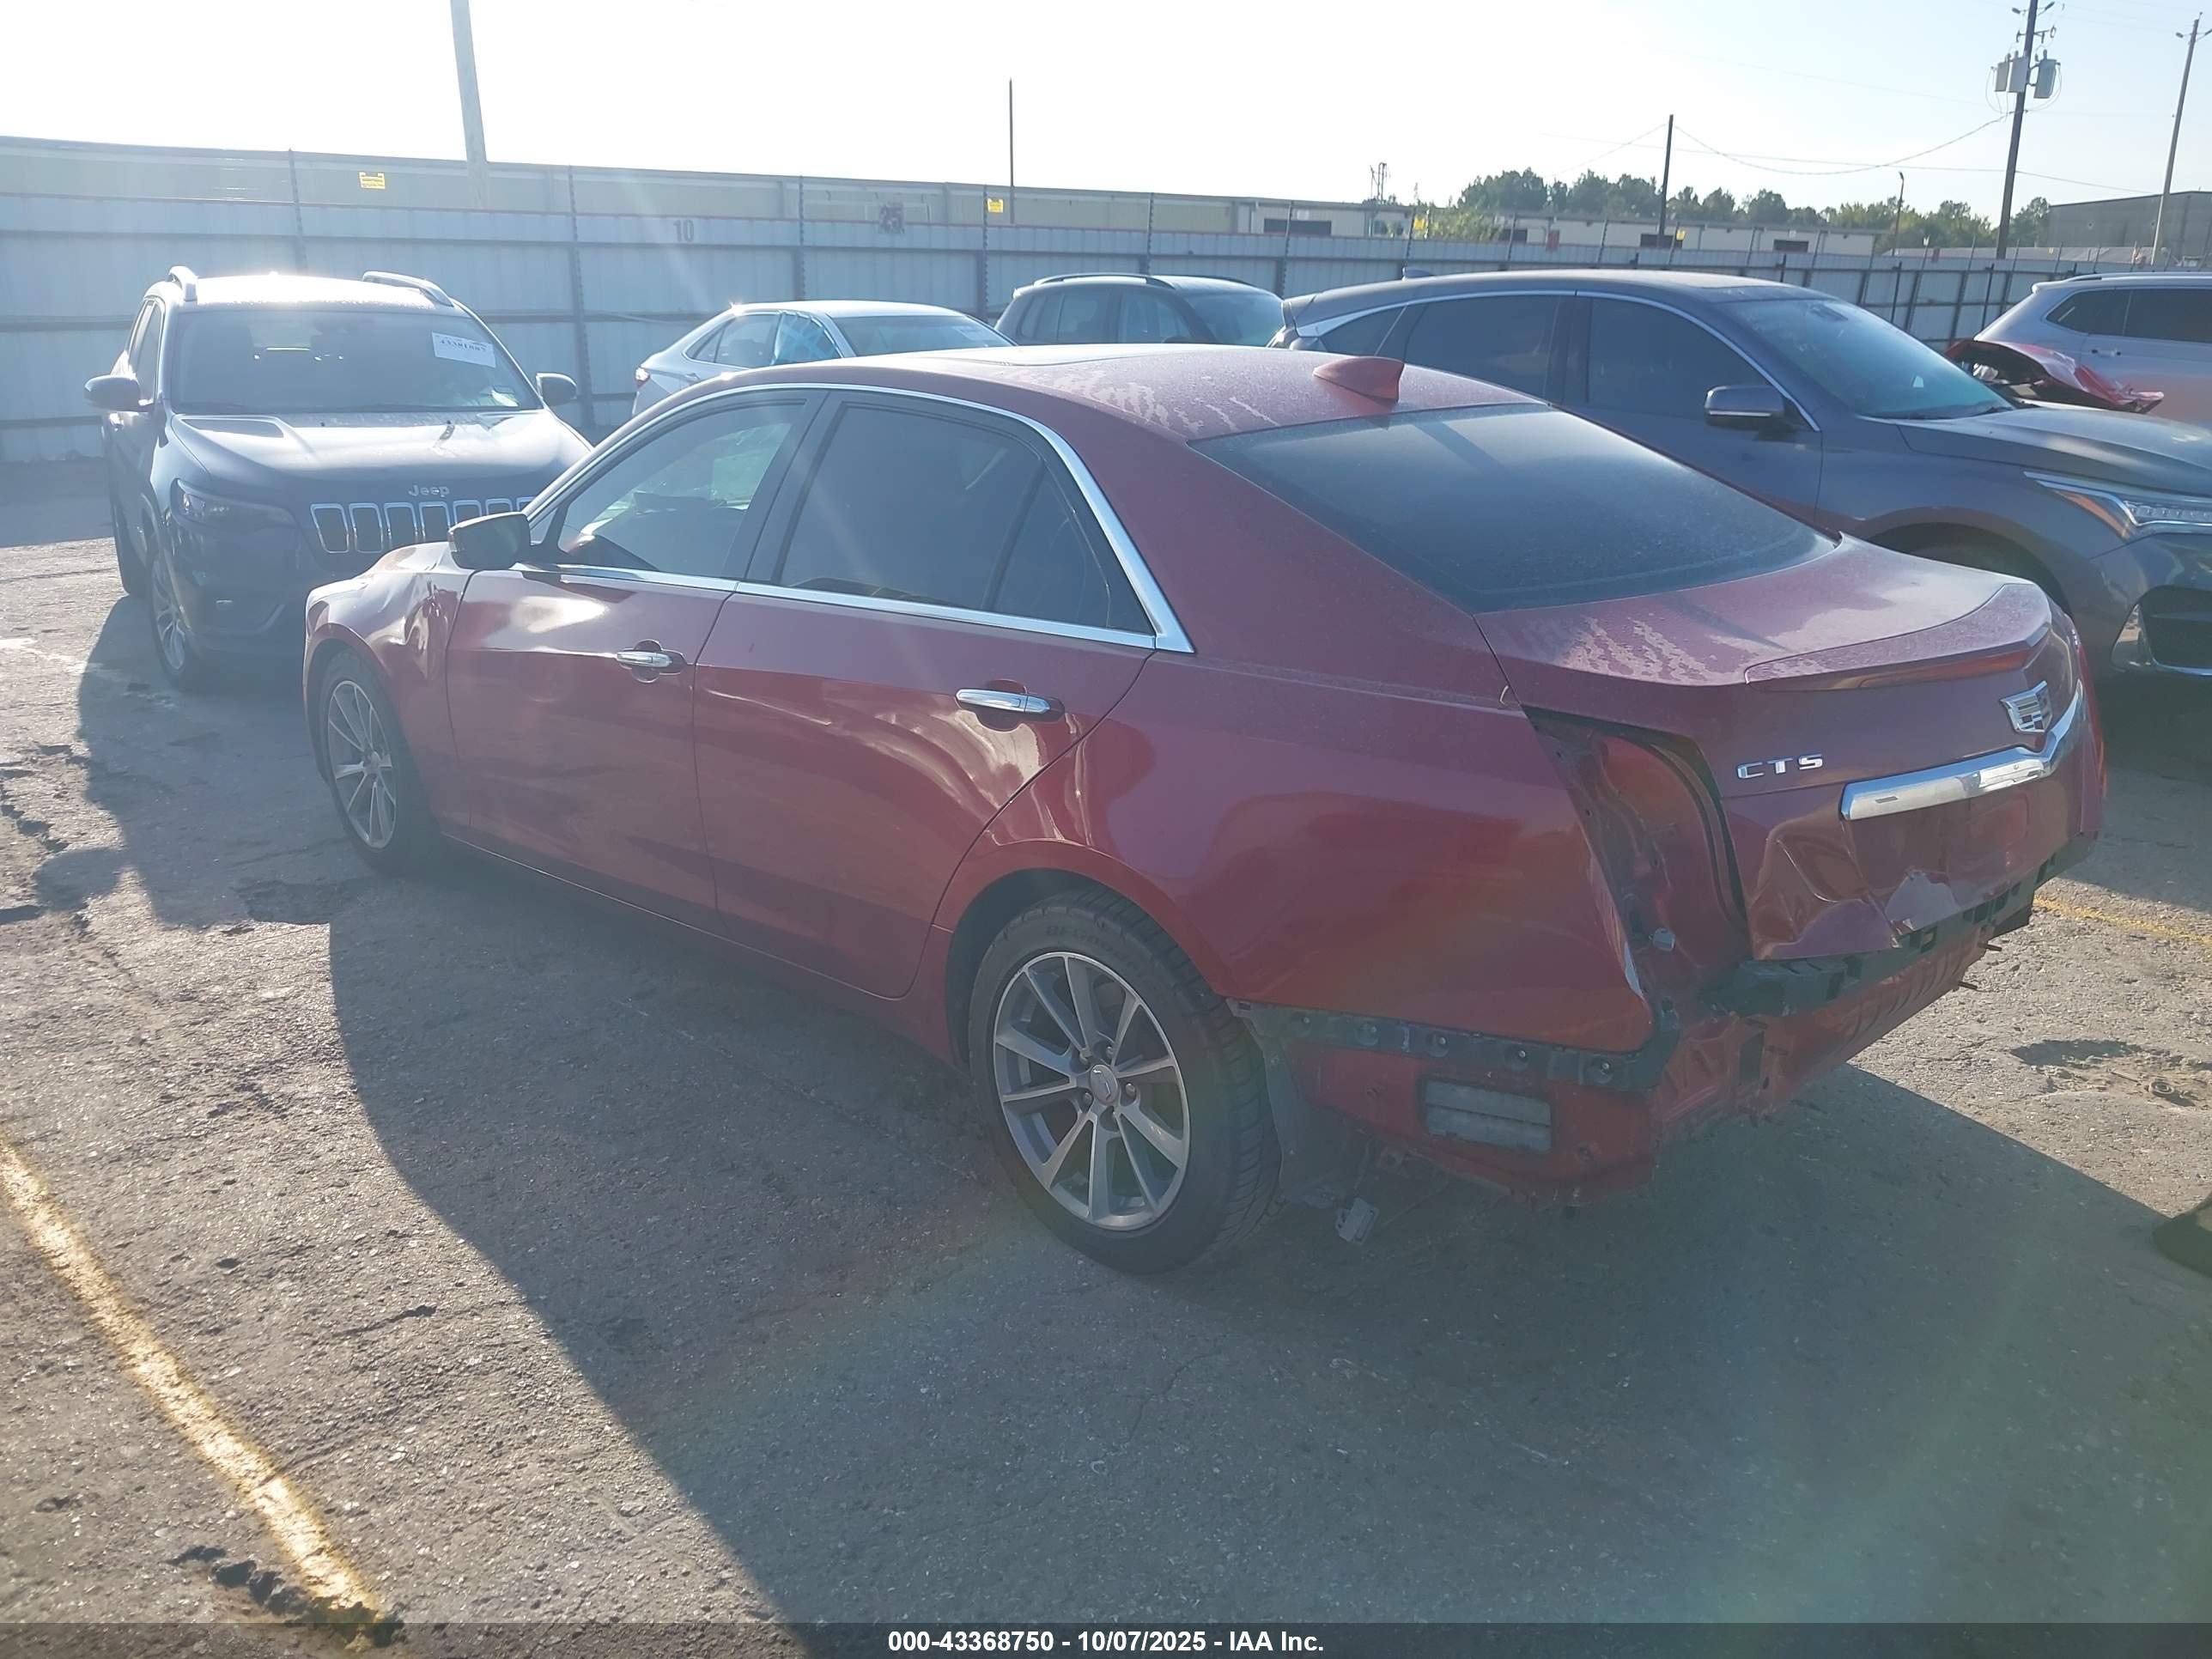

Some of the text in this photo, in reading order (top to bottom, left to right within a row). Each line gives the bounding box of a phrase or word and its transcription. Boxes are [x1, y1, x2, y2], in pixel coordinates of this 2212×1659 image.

[672, 219, 694, 242] 10
[408, 484, 450, 498] Jeep
[1737, 754, 1823, 779] CTS
